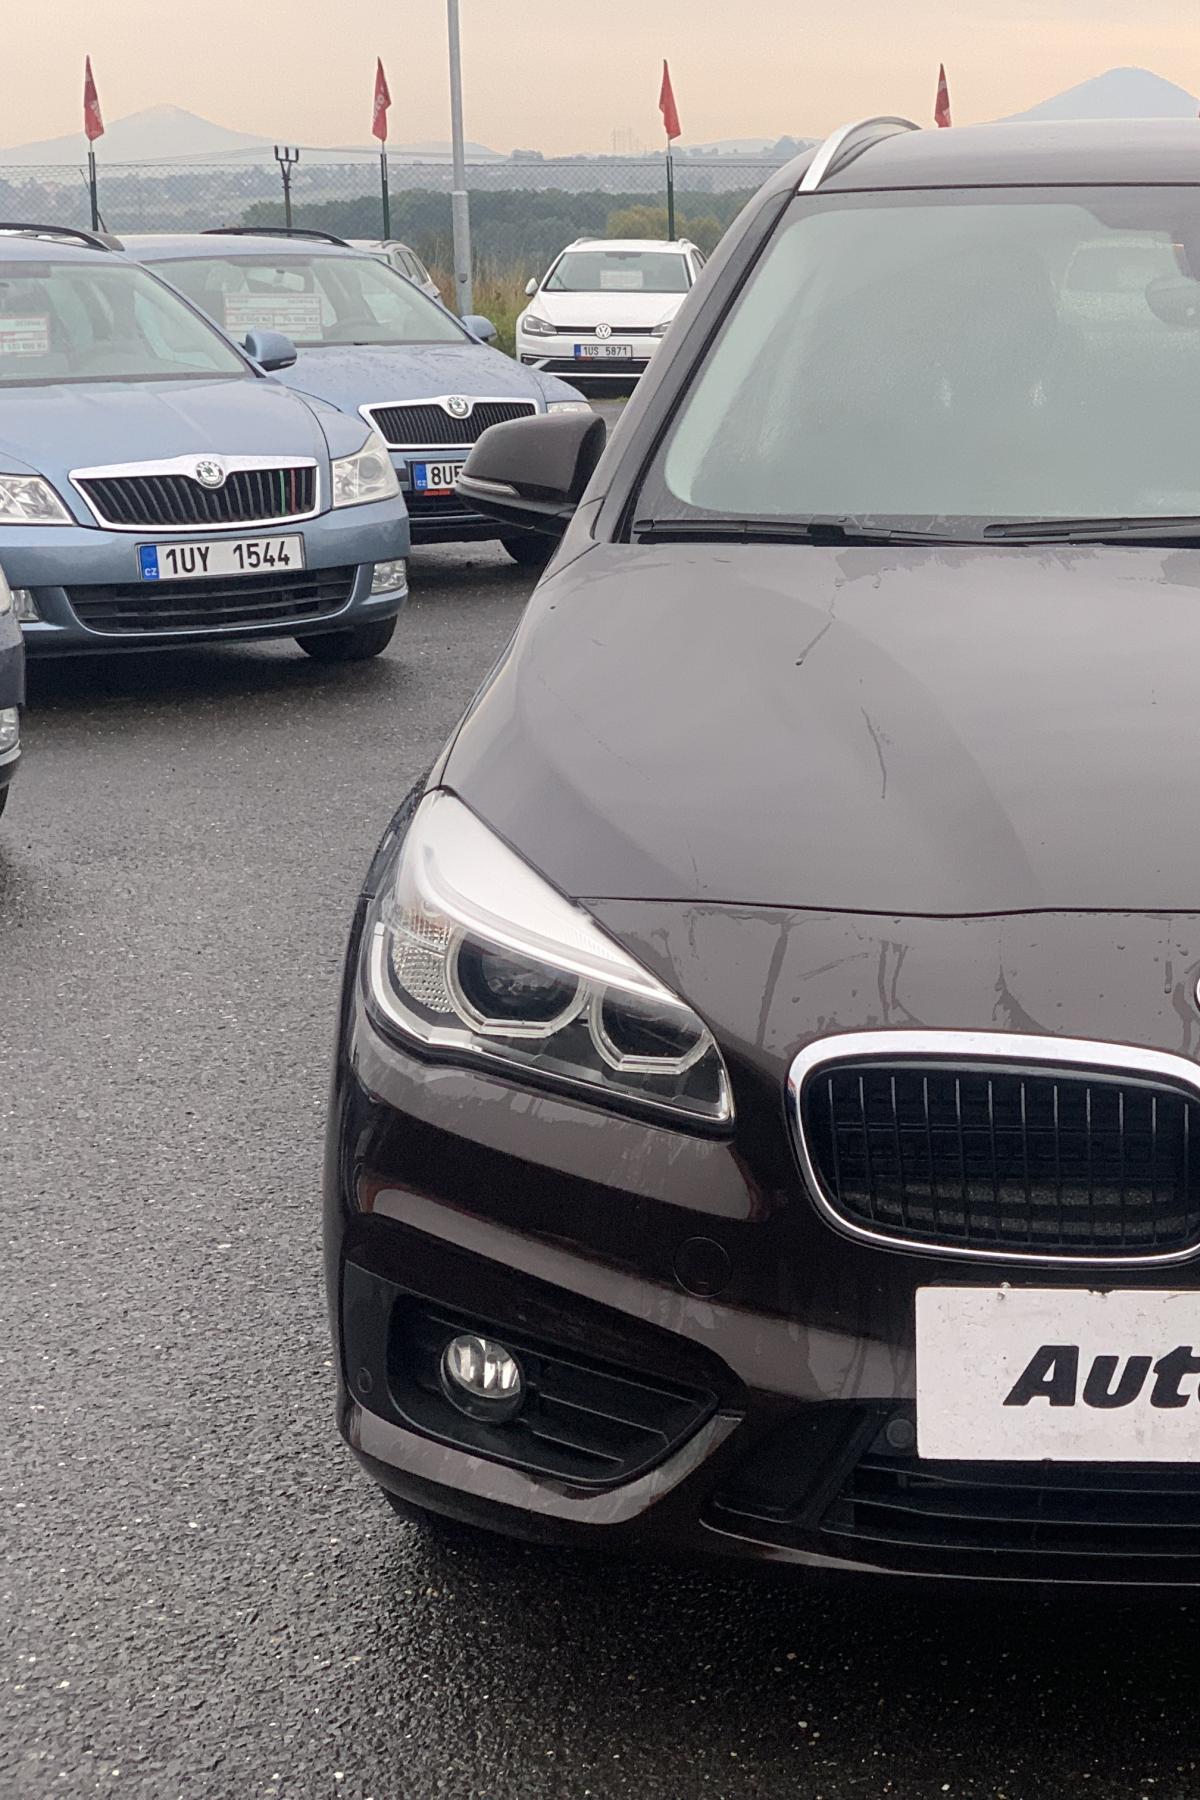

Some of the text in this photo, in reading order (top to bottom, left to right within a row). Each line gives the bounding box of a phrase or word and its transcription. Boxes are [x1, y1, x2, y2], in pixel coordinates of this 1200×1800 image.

[583, 346, 599, 355] 1US
[605, 347, 627, 356] 5871
[166, 541, 290, 574] 1UY 1544
[144, 567, 158, 576] CZ
